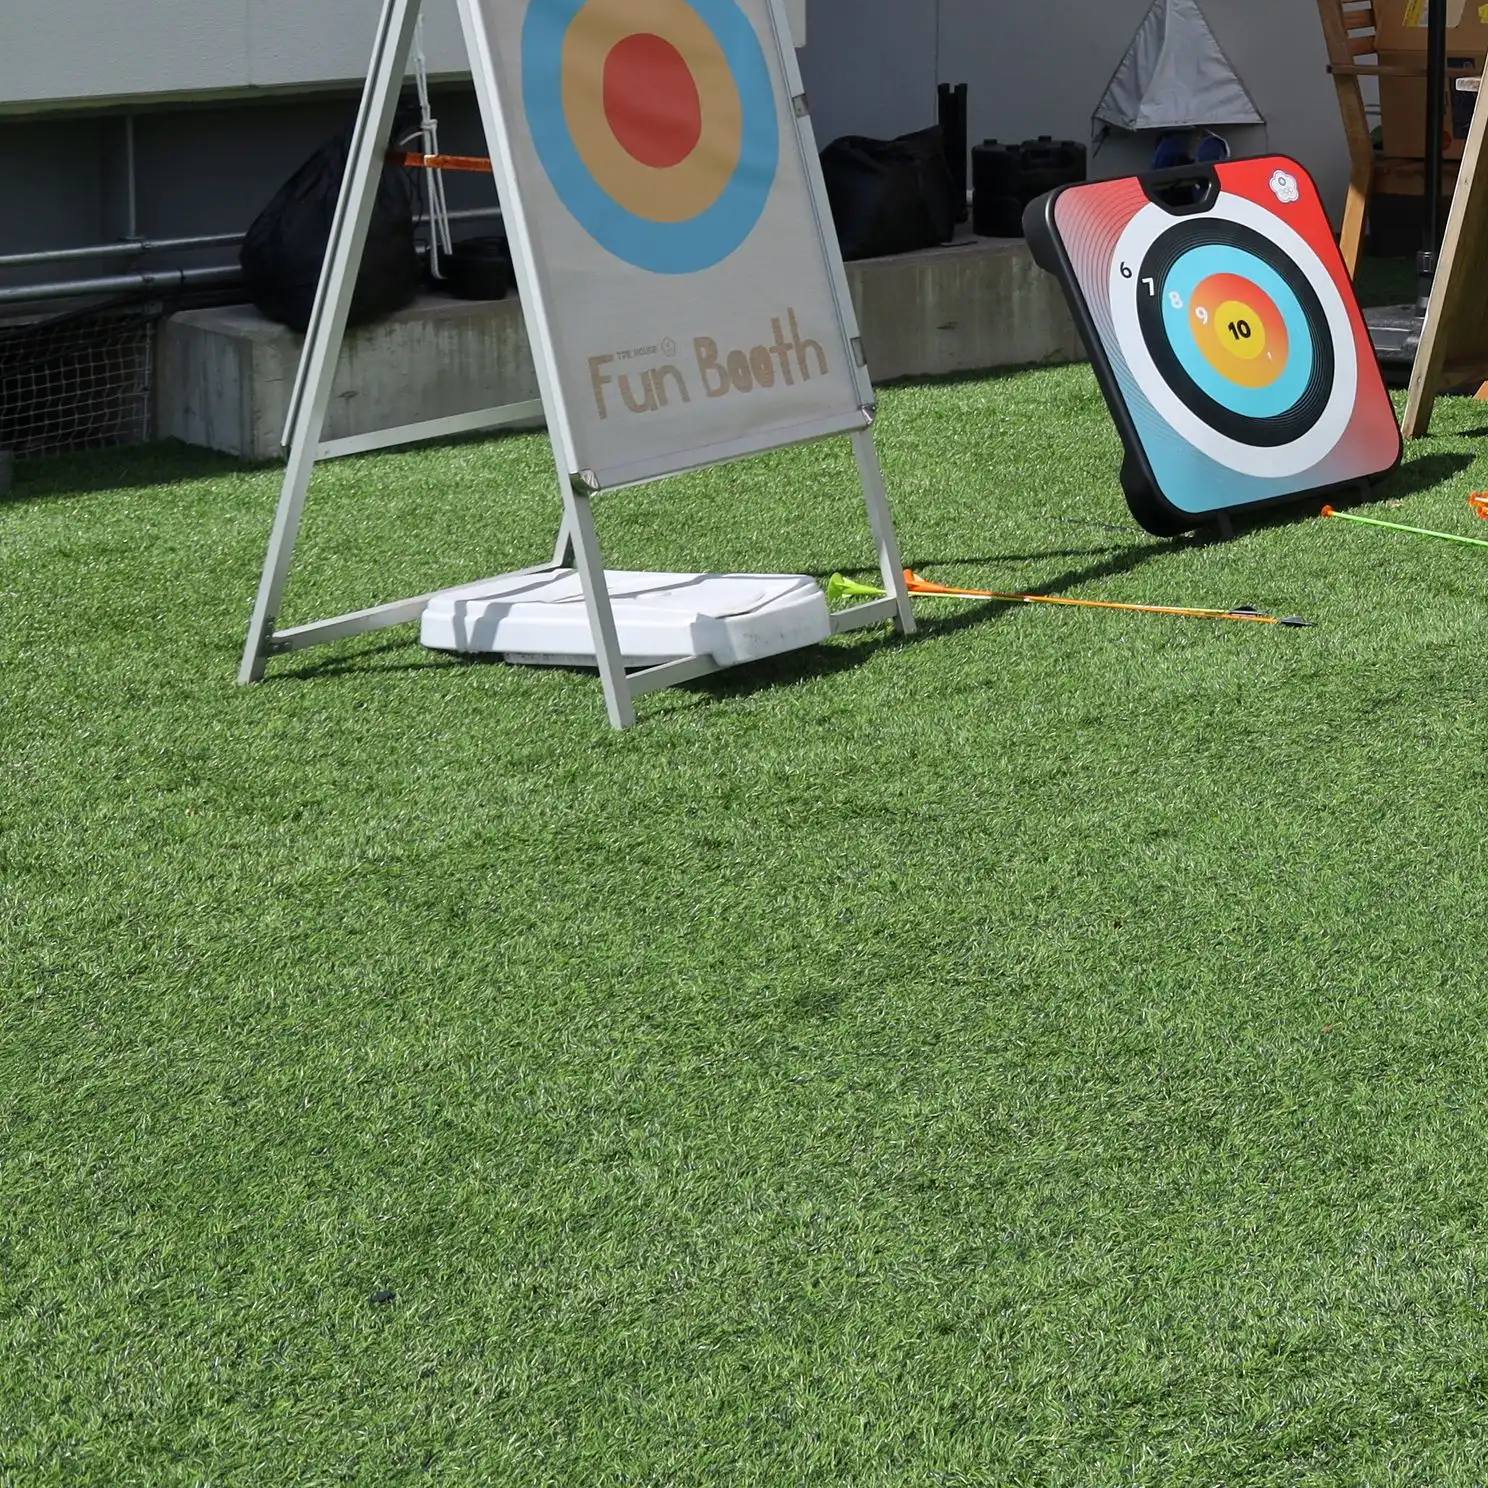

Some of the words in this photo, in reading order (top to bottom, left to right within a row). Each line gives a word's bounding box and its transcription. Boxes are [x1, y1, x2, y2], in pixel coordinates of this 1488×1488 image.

[1119, 261, 1133, 279] 6
[1141, 277, 1156, 297] 7
[1168, 290, 1184, 310] 8
[1195, 305, 1209, 325] 9
[1227, 319, 1252, 341] 10
[587, 353, 692, 420] Fun
[693, 306, 830, 399] Booth
